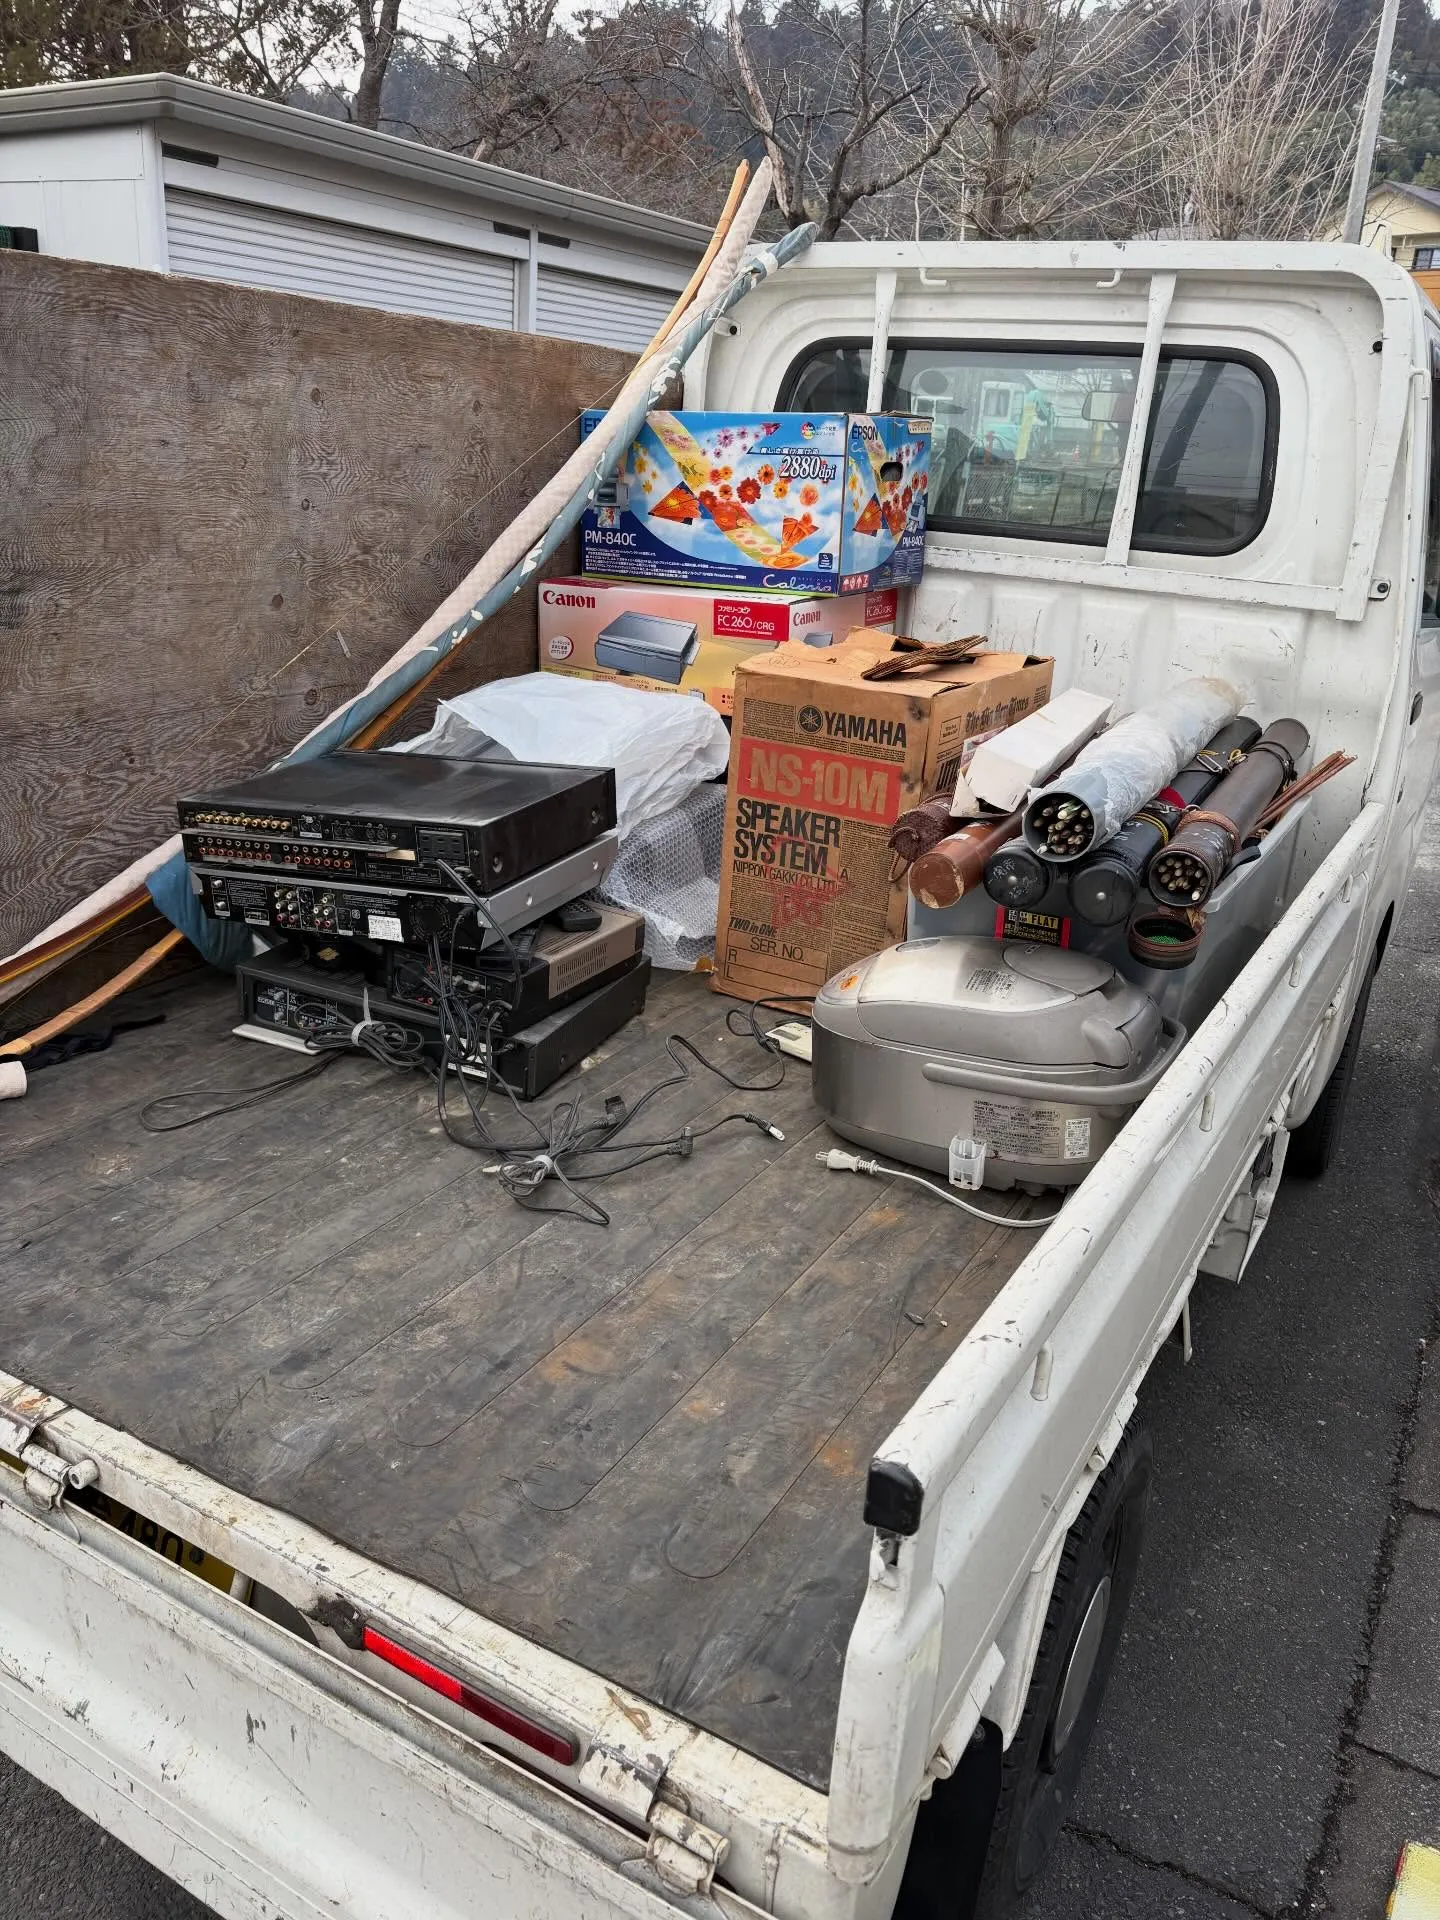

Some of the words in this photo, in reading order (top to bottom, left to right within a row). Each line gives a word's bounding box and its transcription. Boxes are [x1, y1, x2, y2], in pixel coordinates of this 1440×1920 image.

[852, 423, 878, 440] EPSON
[779, 455, 837, 483] 2880dpi
[585, 530, 637, 546] PM-840C
[543, 590, 596, 609] Canon
[793, 610, 821, 627] Canon
[824, 710, 907, 748] YAMAHA
[750, 747, 889, 816] NS-10M
[736, 798, 841, 848] SPEAKER
[734, 829, 829, 876] SYSTEM
[733, 860, 767, 879] NIPPON
[770, 867, 799, 885] GAKKI
[729, 916, 751, 930] TWO
[750, 922, 759, 933] in
[759, 924, 777, 937] ONE
[728, 948, 738, 962] R
[750, 936, 779, 956] SER.
[782, 944, 805, 961] NO.
[726, 965, 735, 980] L
